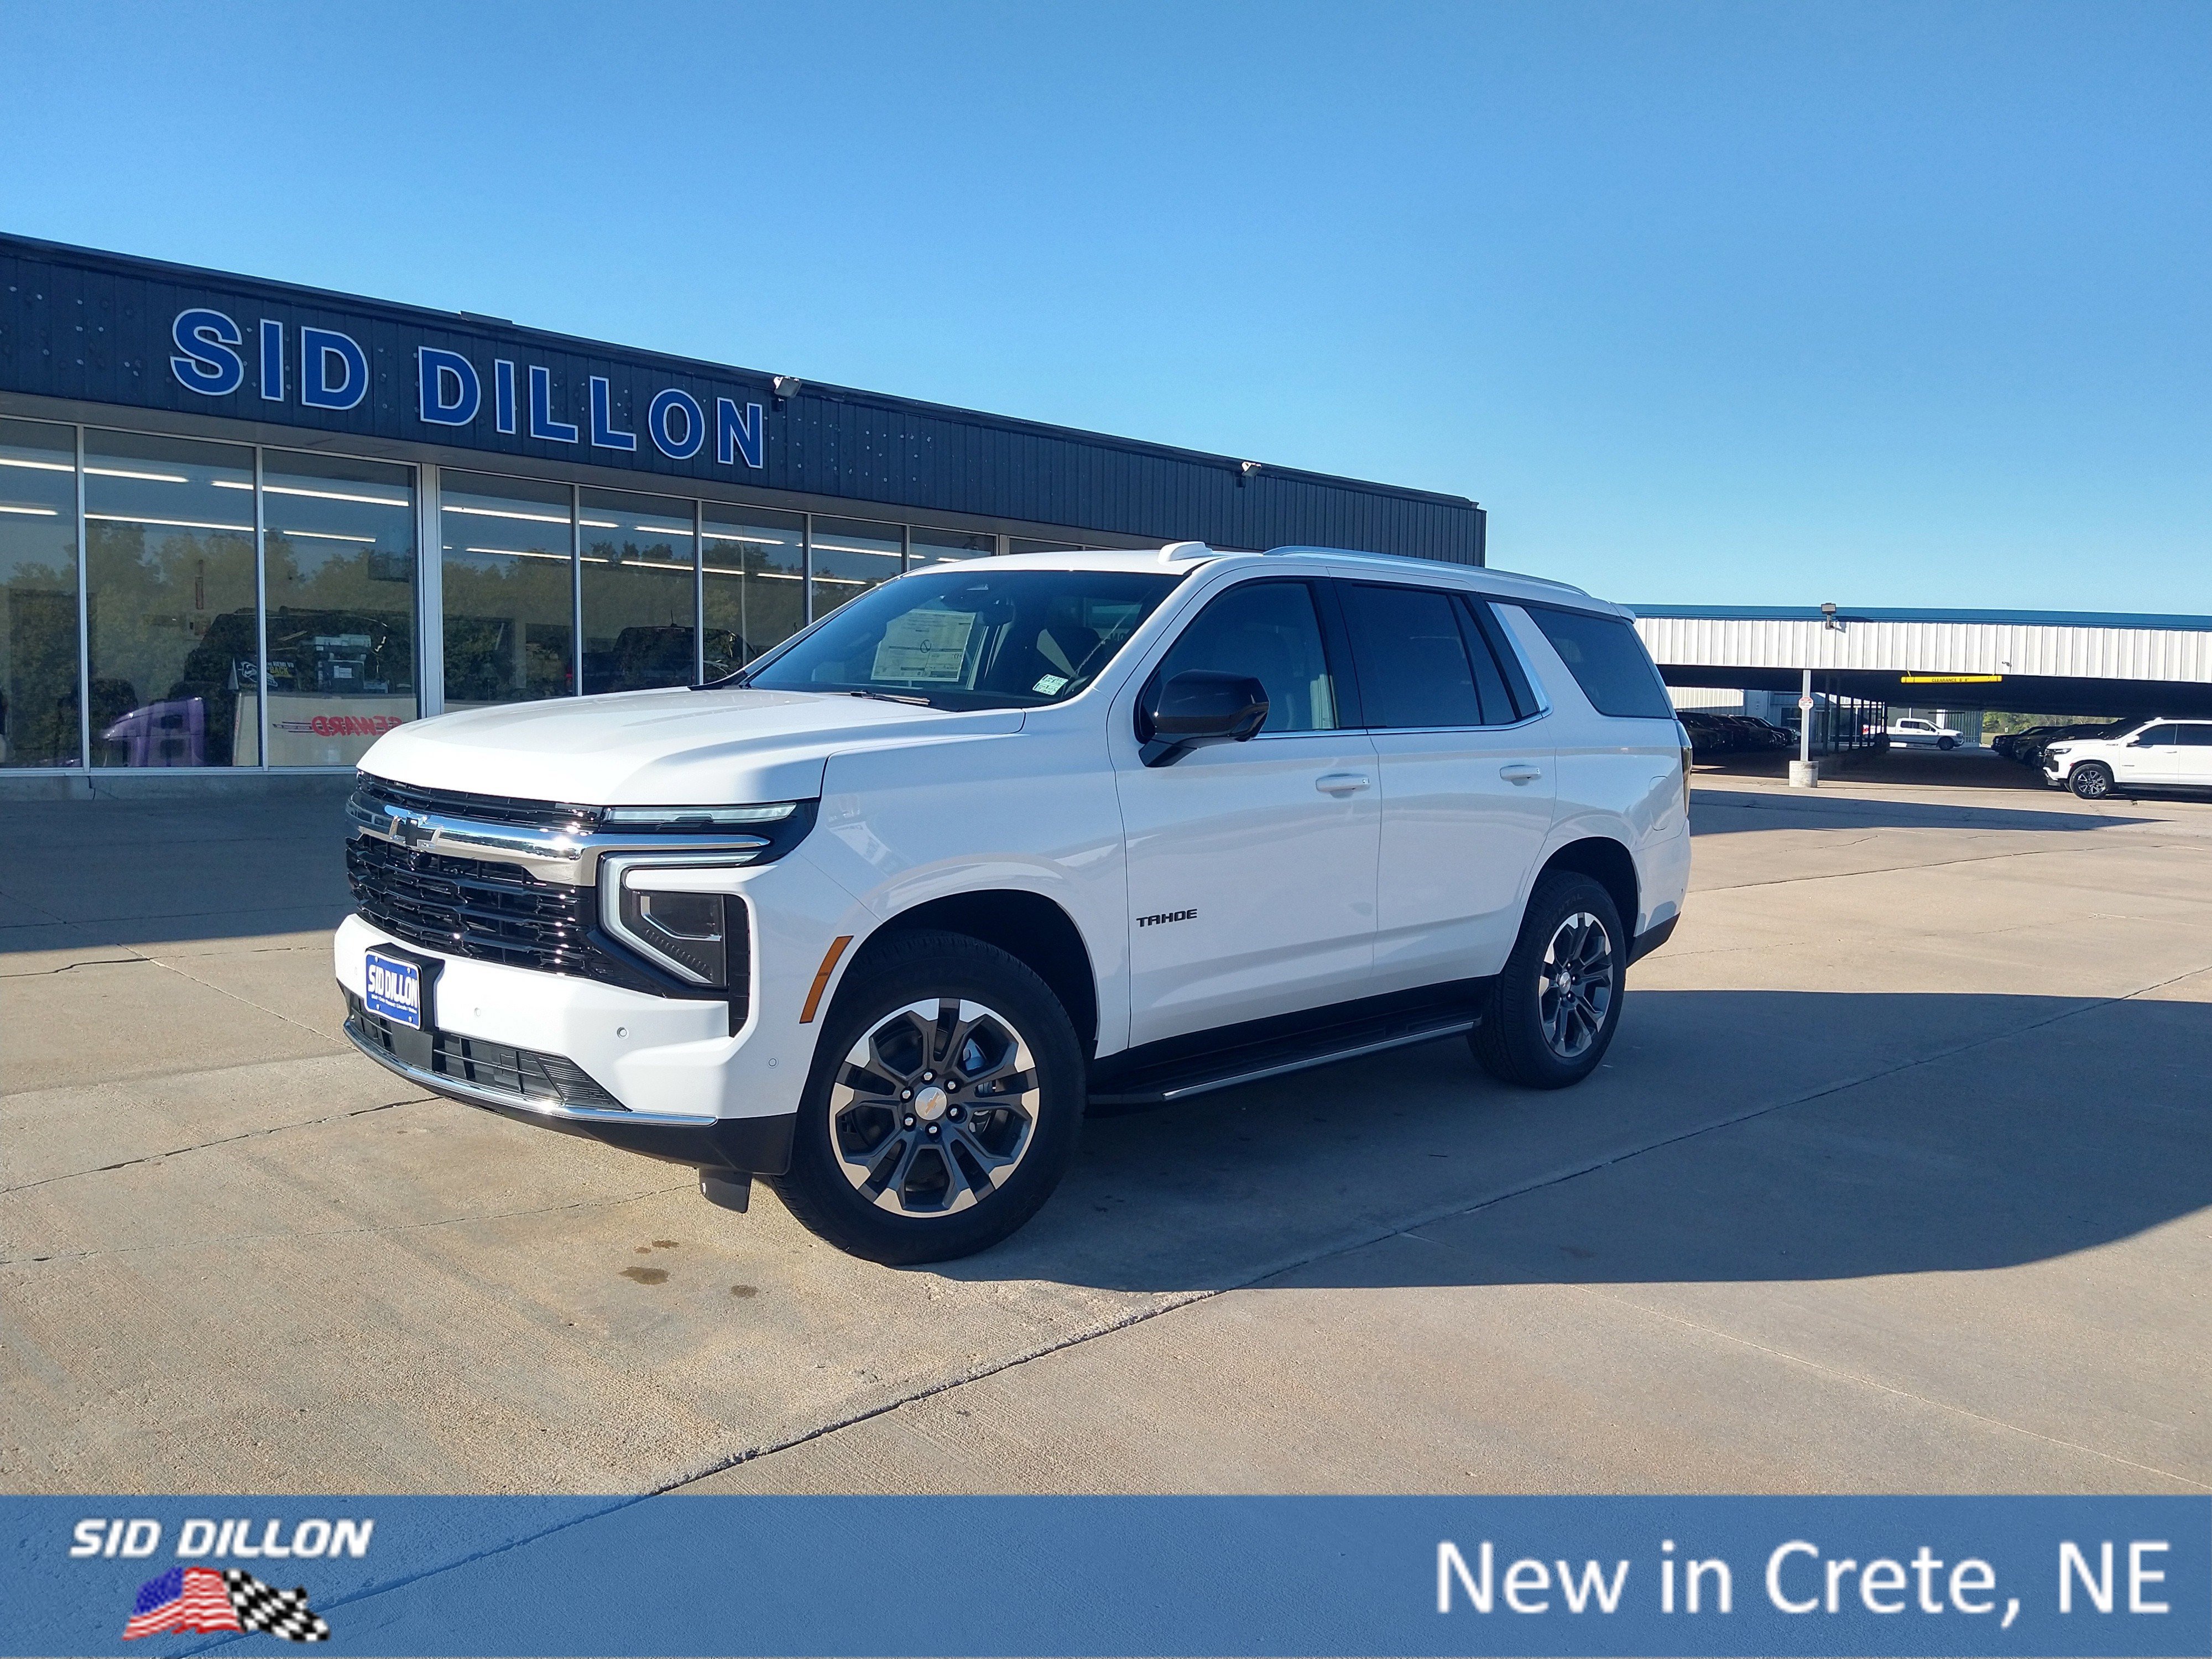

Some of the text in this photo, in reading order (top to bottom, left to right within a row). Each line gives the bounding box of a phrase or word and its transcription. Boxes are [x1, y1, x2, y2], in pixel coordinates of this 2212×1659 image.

[170, 307, 763, 469] SID DILLON
[270, 666, 288, 675] BACK
[1136, 909, 1197, 927] TAHOE
[368, 964, 418, 1008] SID DILLON
